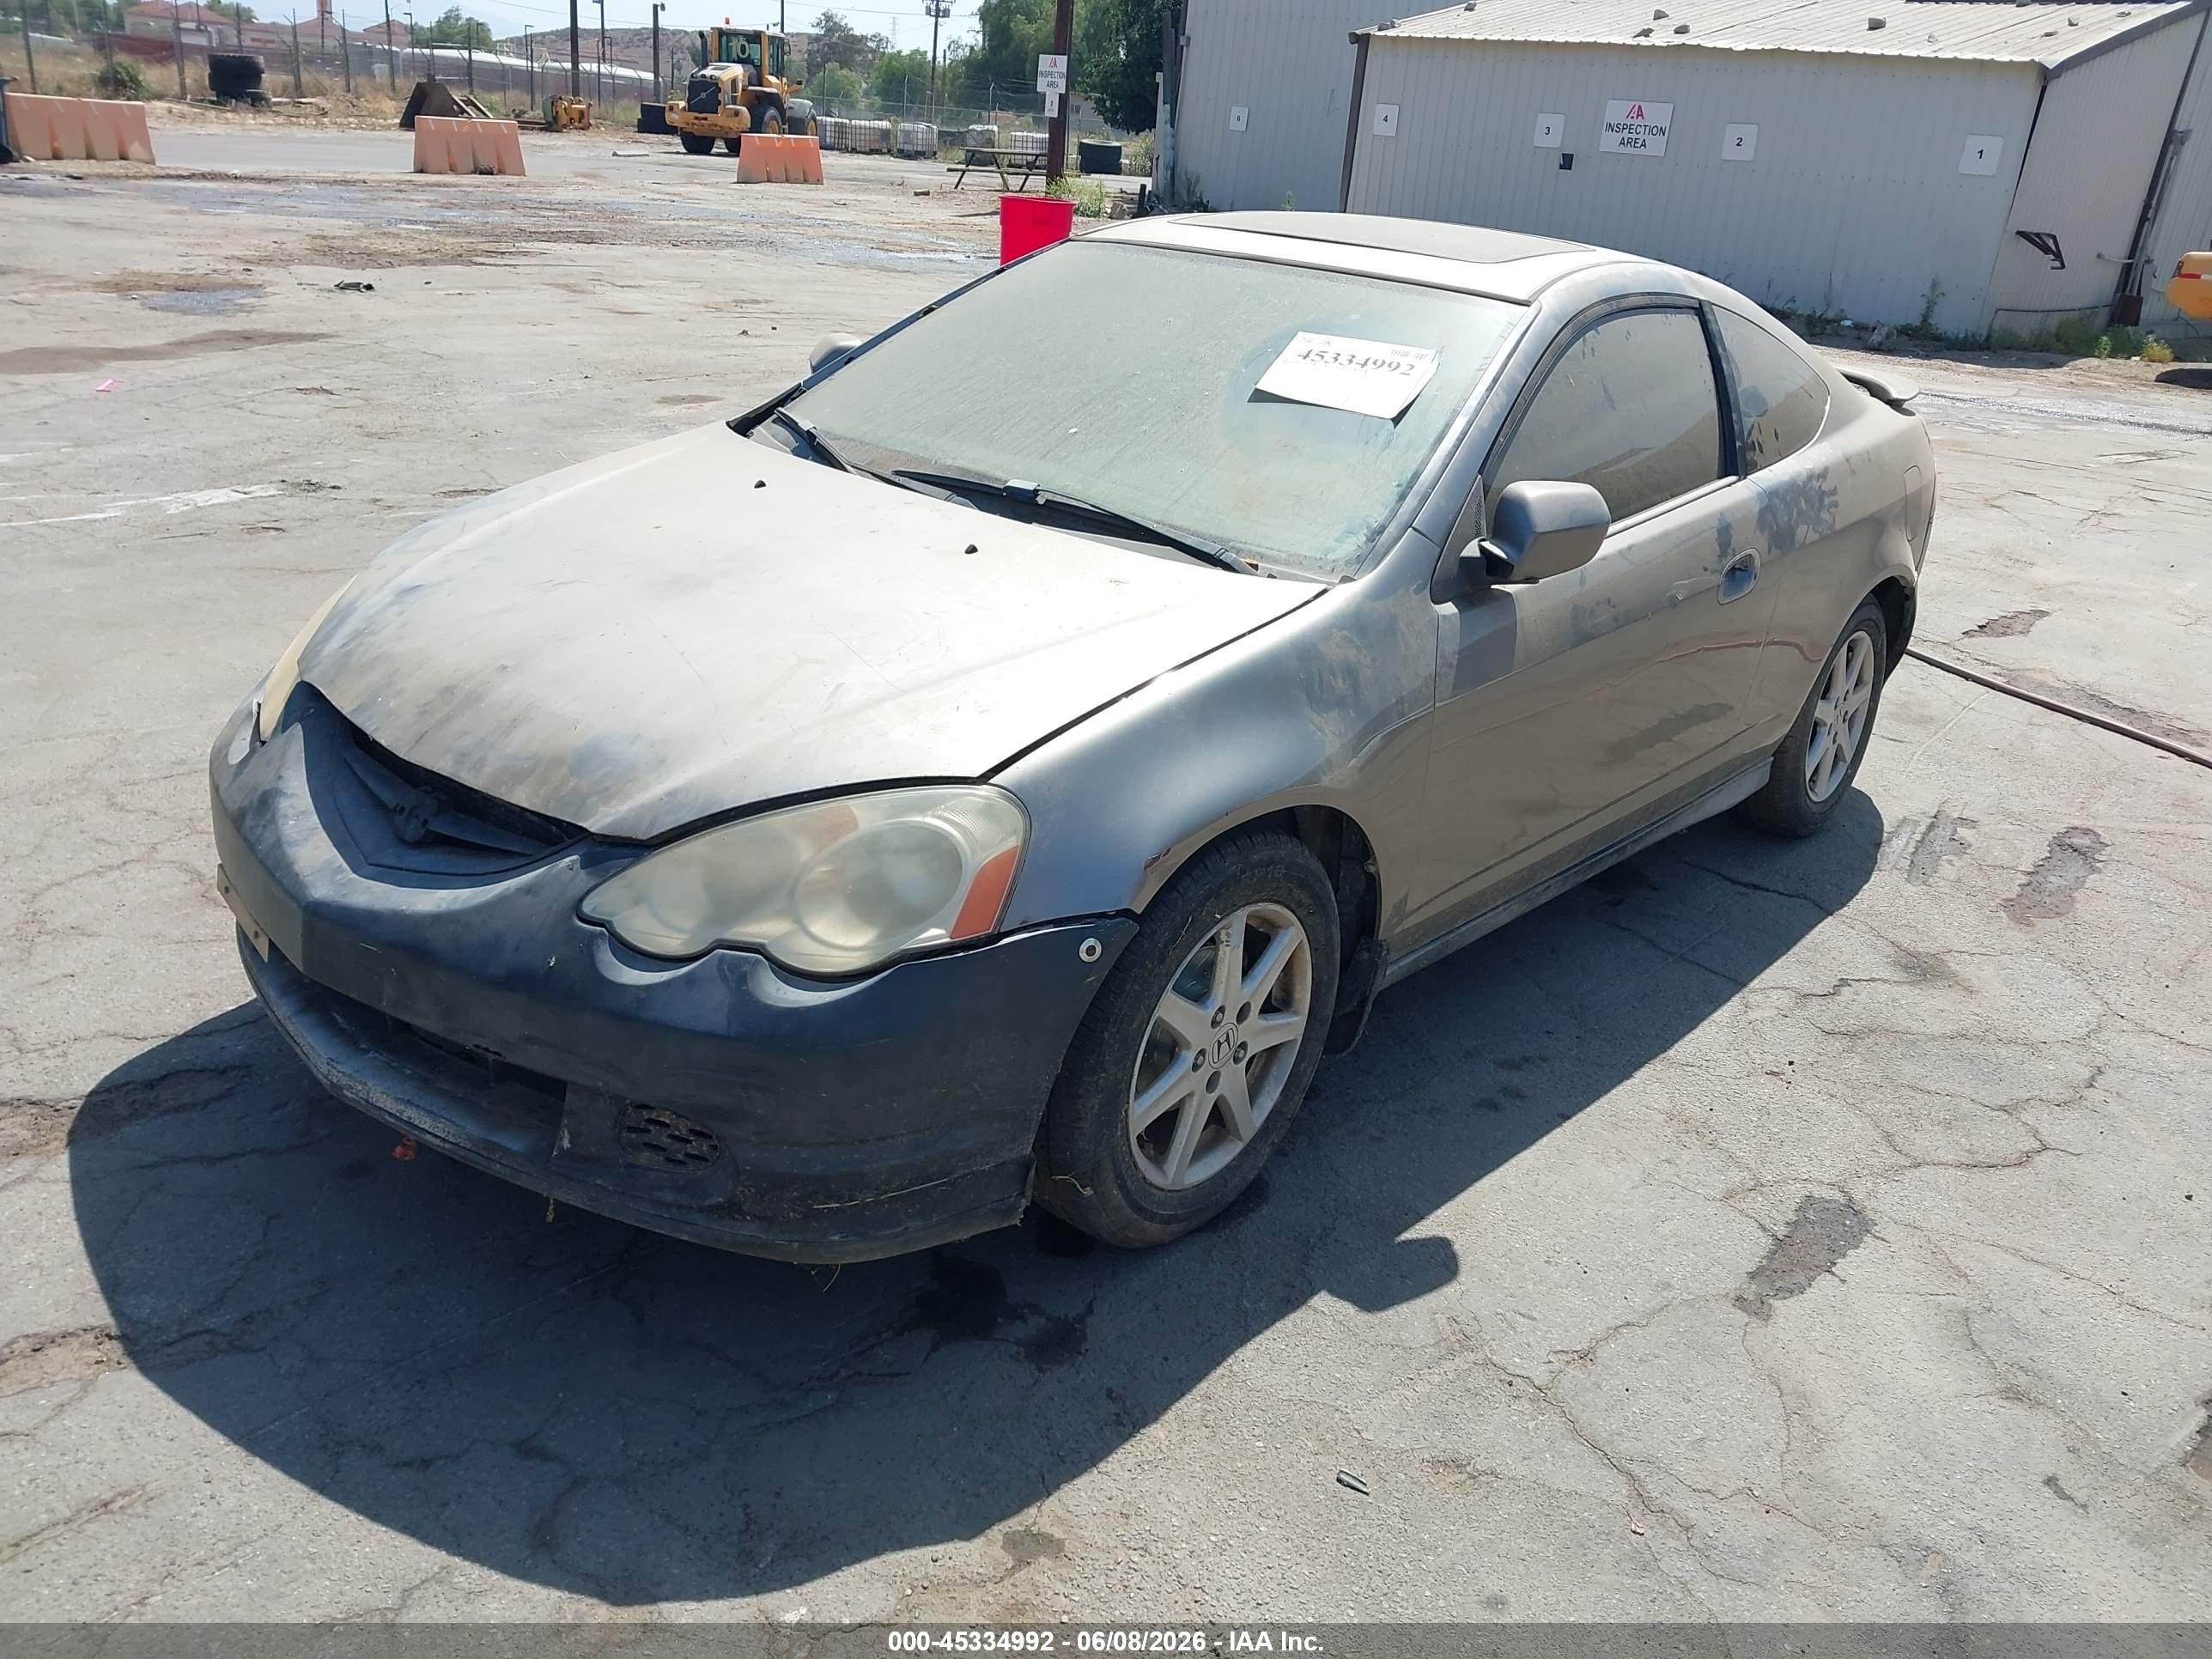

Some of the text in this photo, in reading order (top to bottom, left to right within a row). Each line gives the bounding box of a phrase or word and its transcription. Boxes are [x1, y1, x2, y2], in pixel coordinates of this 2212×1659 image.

[1382, 114, 1389, 123] 4
[1545, 126, 1551, 136] 3
[1605, 122, 1667, 137] INSPECTION
[1619, 137, 1647, 149] AREA
[1735, 137, 1743, 147] 2
[1978, 149, 1984, 160] 1
[1297, 349, 1415, 376] 45334992
